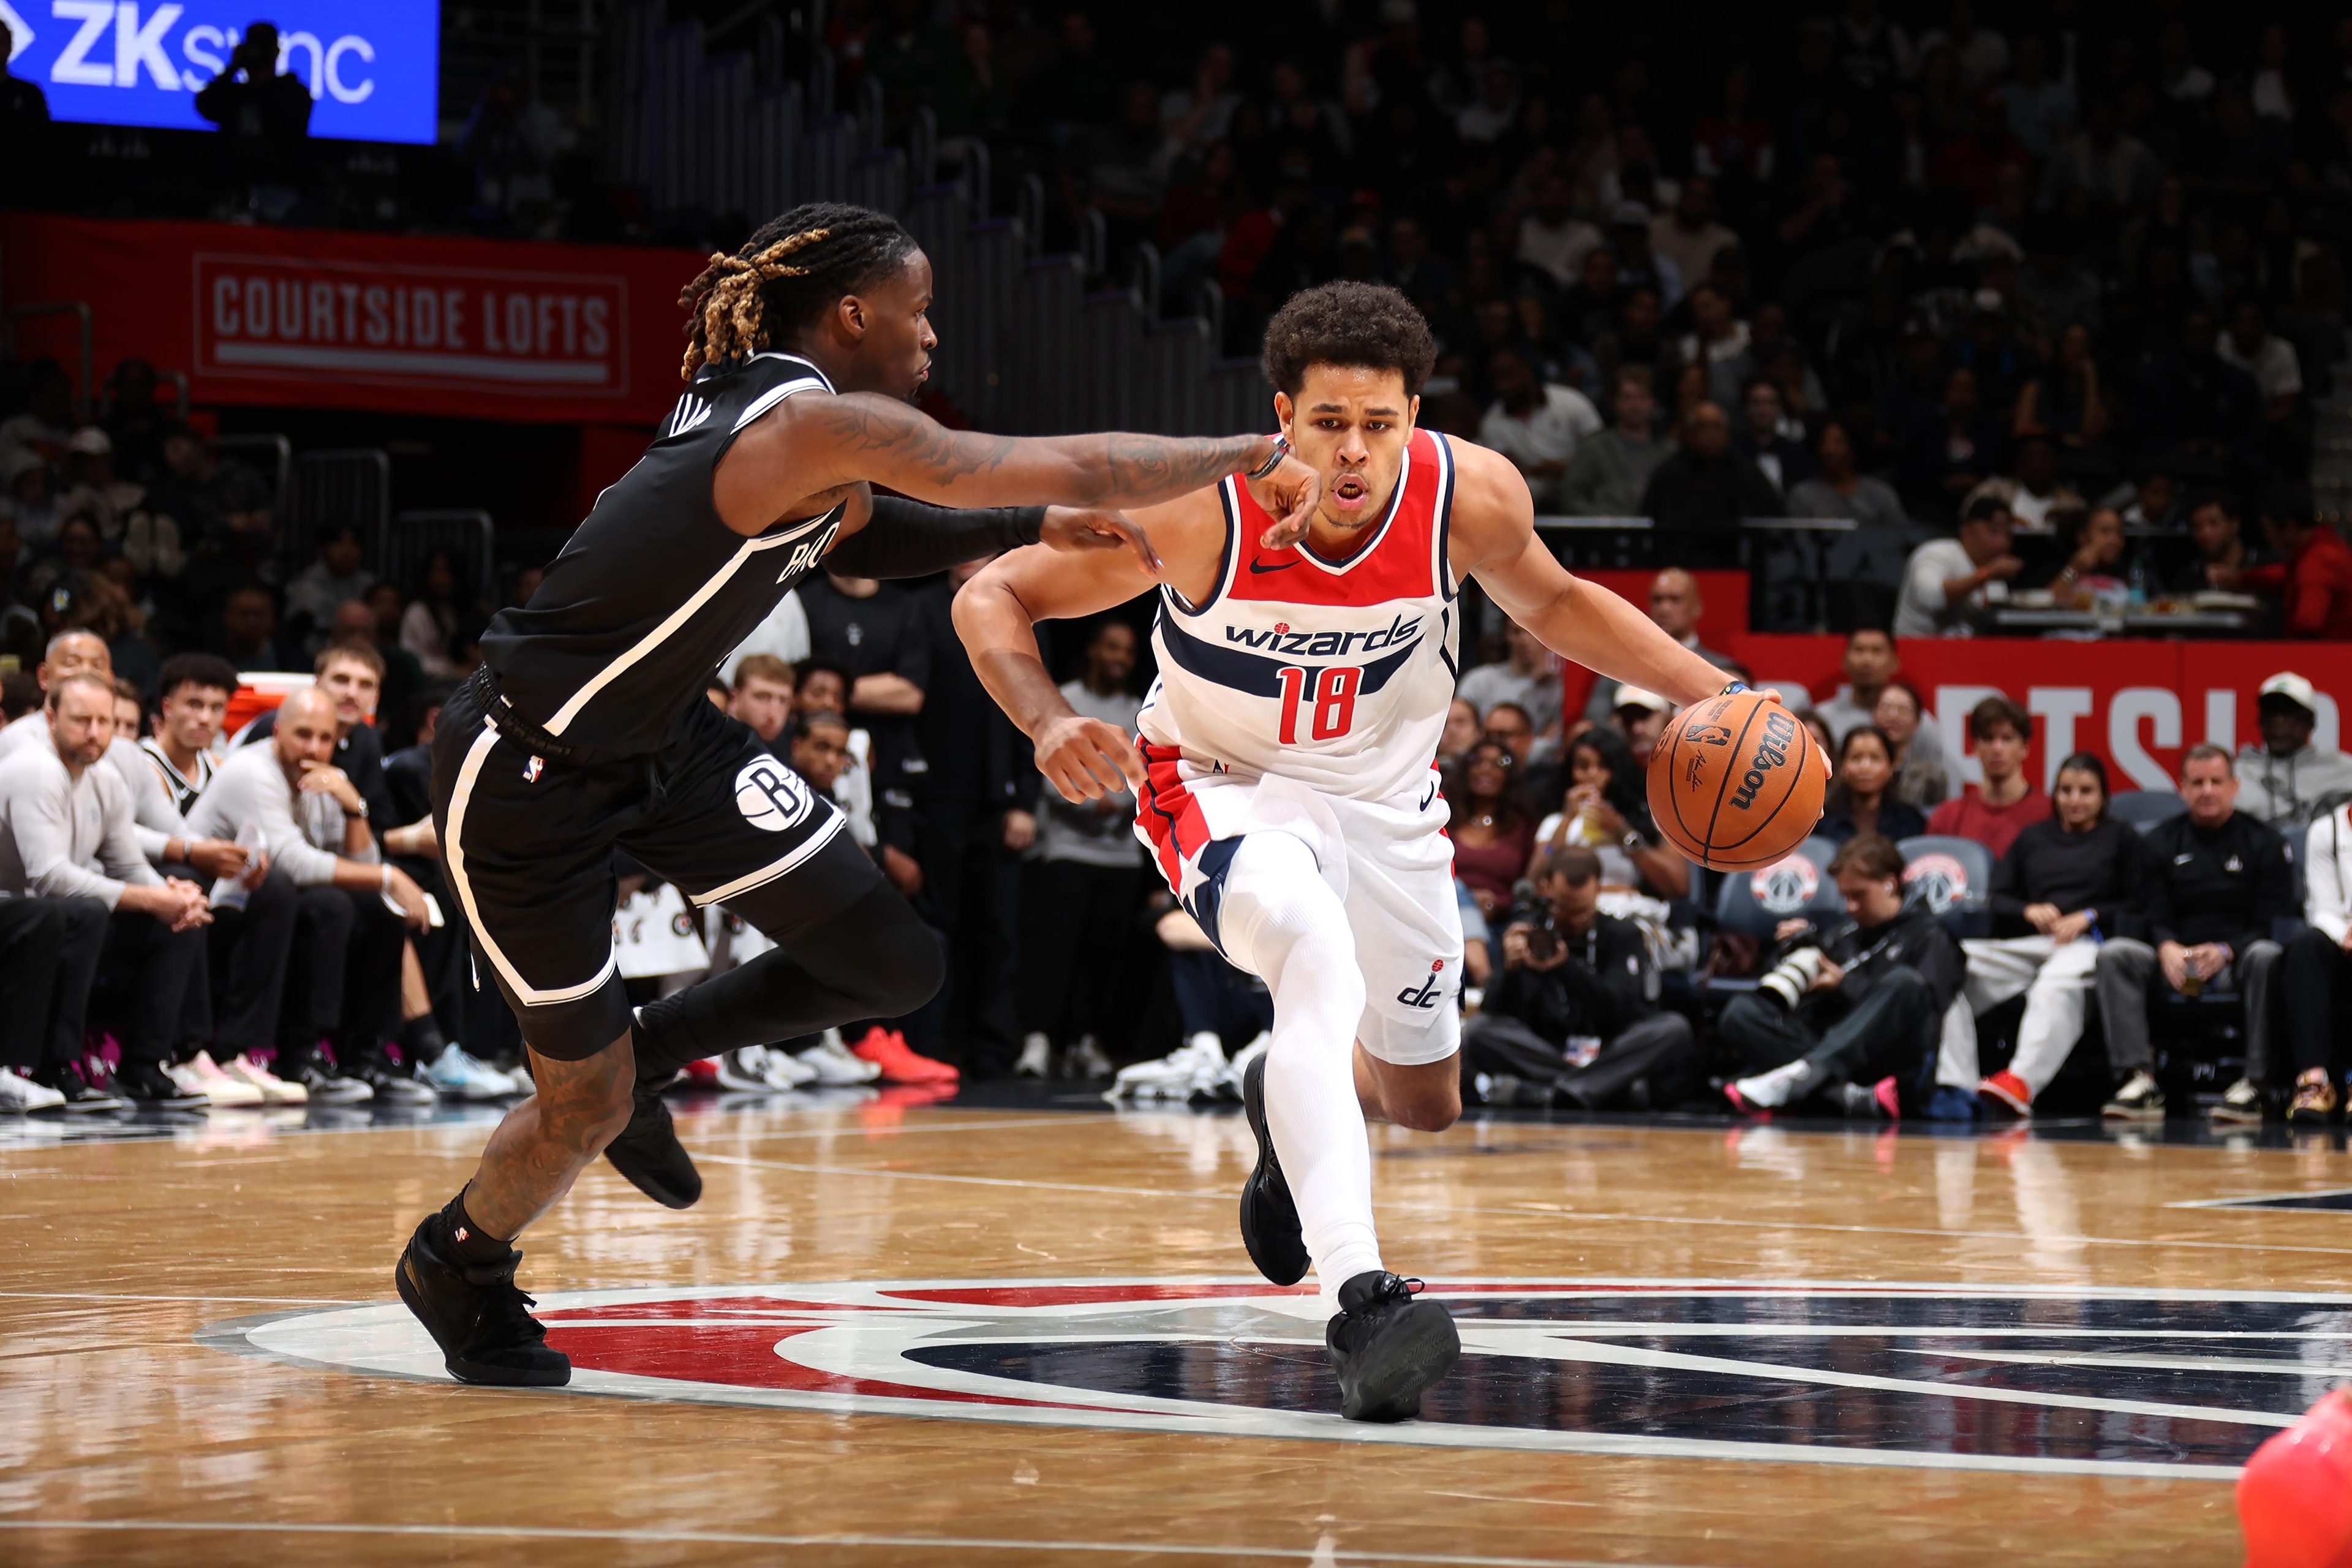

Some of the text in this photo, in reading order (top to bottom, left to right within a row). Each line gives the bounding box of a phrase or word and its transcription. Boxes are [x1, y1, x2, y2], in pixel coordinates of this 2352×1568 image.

[50, 0, 375, 104] ZKsnc
[214, 276, 609, 356] COURTSIDE LOFTS
[1225, 614, 1426, 657] wizards
[1277, 666, 1363, 744] 18
[749, 767, 800, 820] B
[1728, 712, 1796, 811] Wilson
